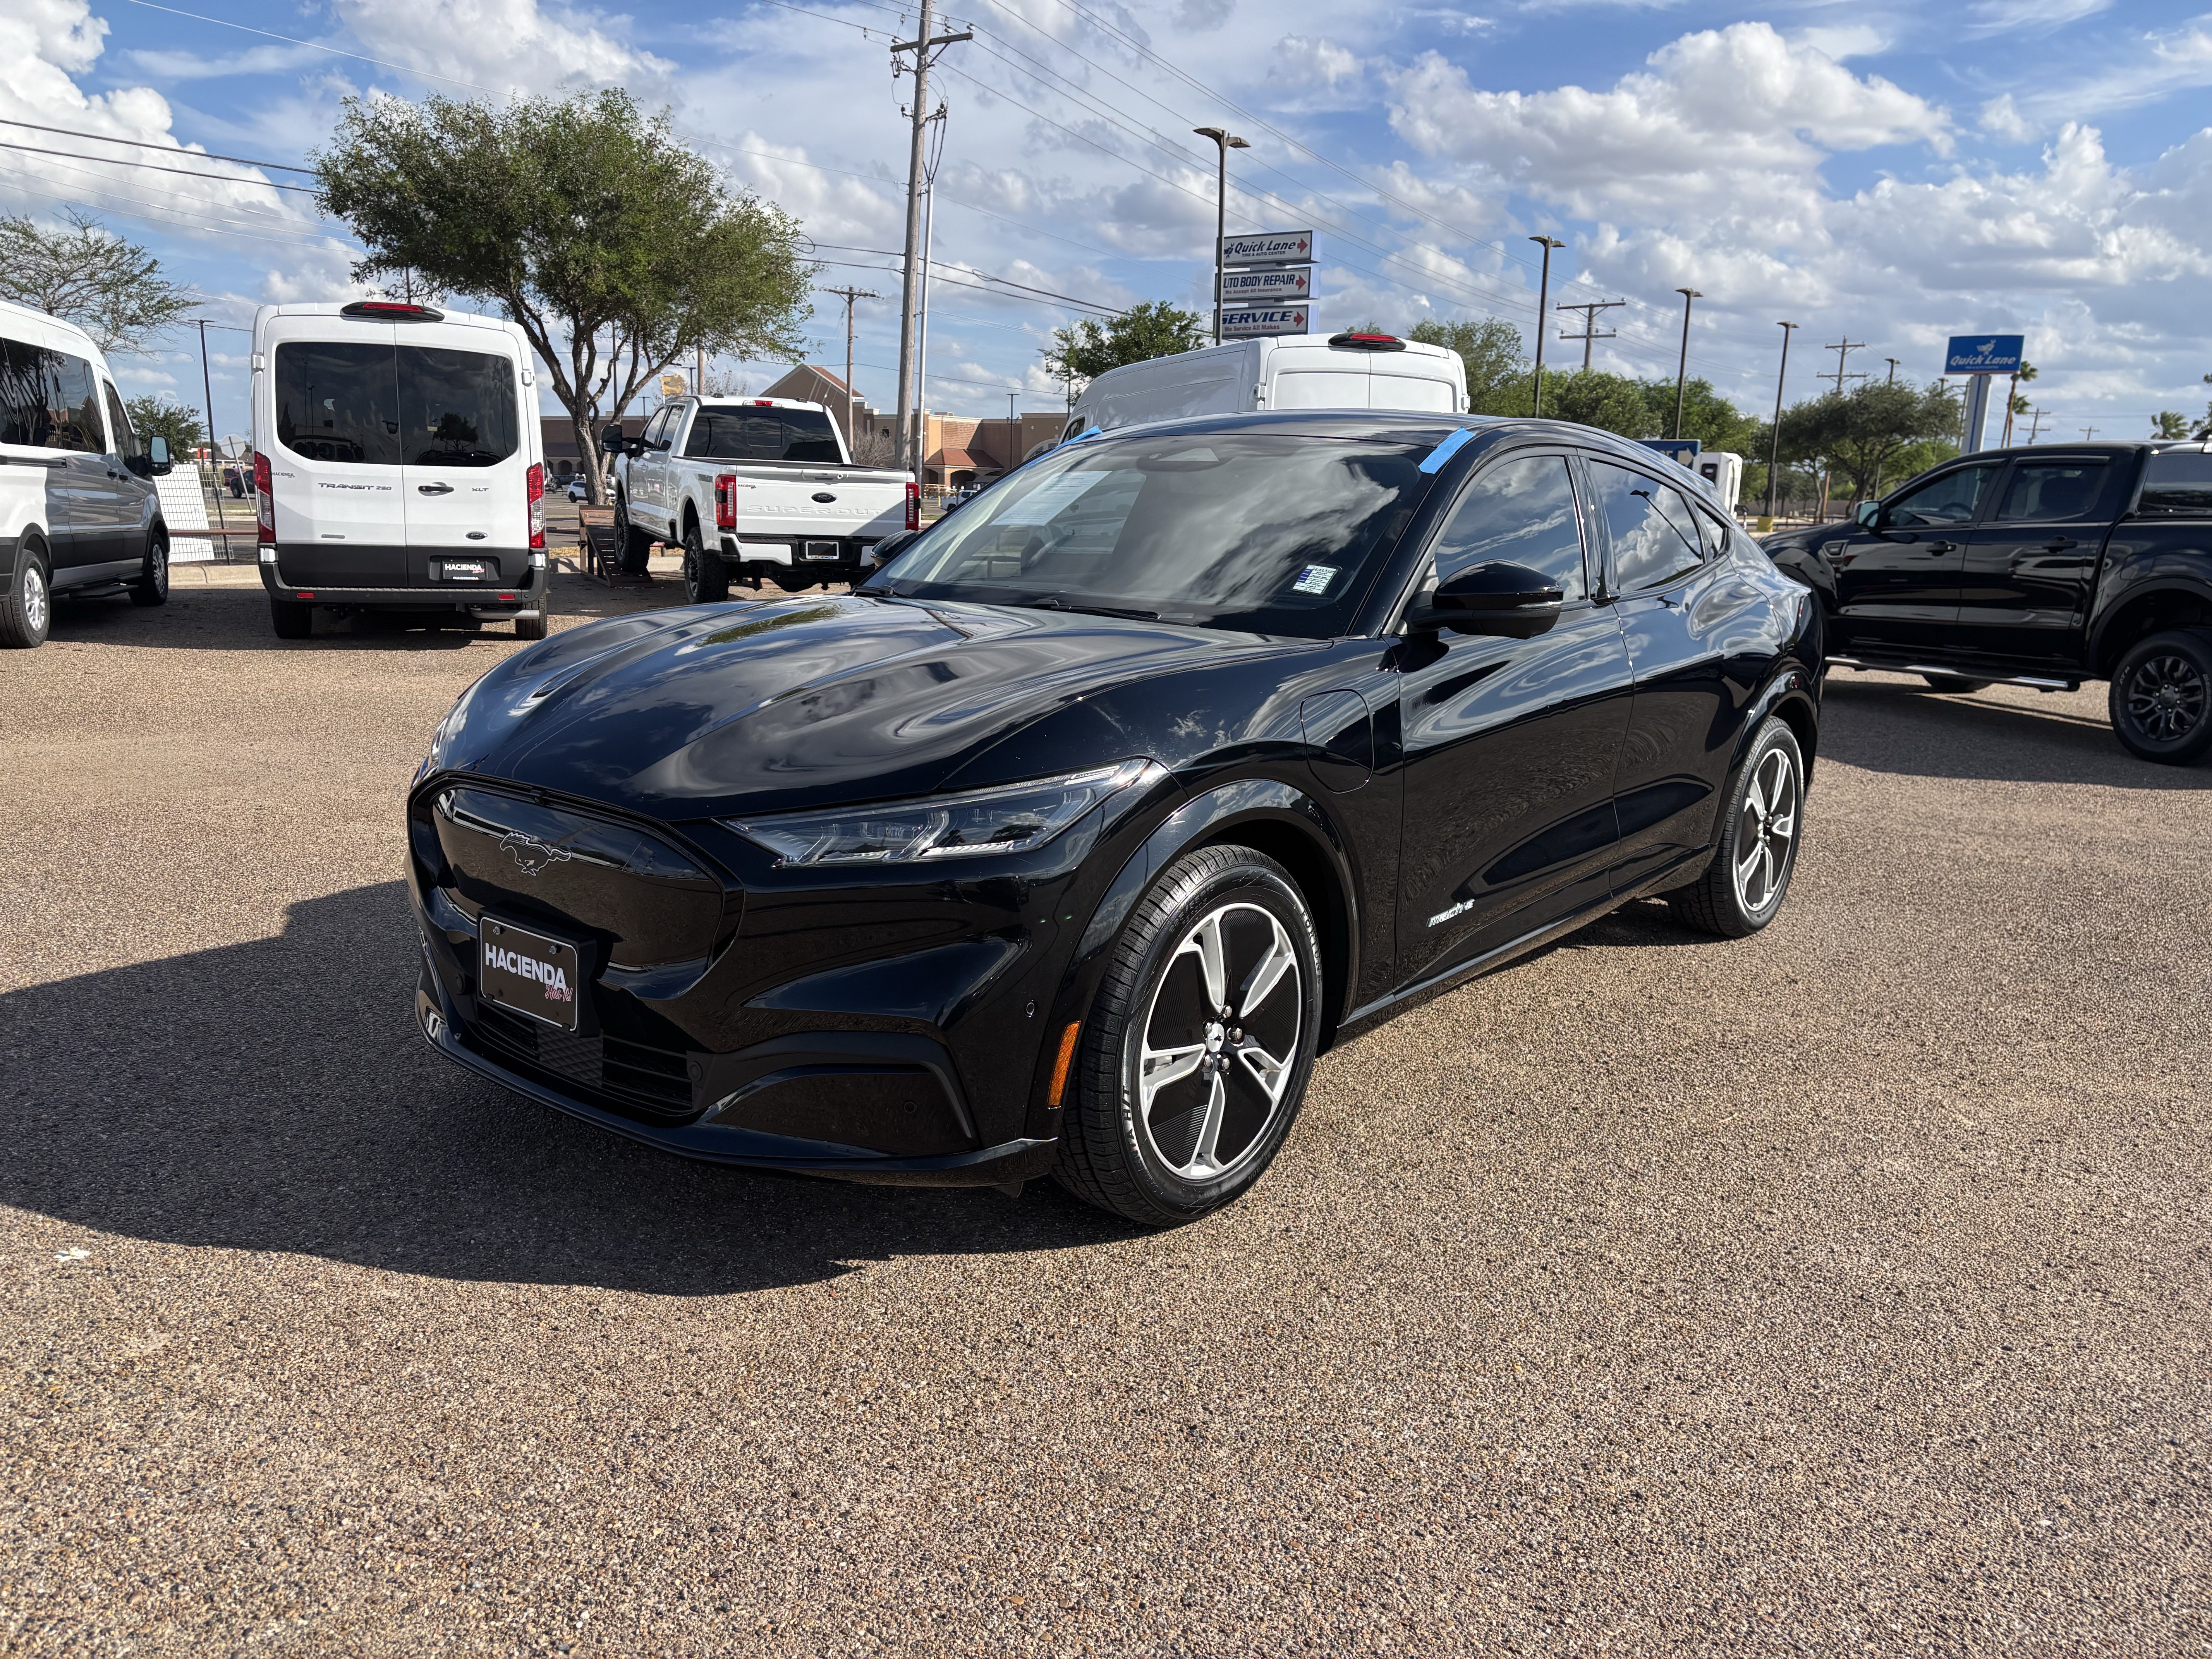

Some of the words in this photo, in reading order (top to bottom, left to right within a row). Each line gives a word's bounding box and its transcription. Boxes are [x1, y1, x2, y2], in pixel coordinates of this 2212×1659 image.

[1235, 241, 1265, 254] Quick
[1266, 240, 1296, 251] Lane
[1223, 277, 1239, 288] UTO
[1240, 275, 1263, 287] BODY
[1263, 274, 1295, 286] REPAIR
[1222, 311, 1293, 325] SERVICE
[1950, 354, 1984, 366] Quick
[1984, 354, 2016, 364] Lane
[747, 505, 830, 515] SUPER
[485, 942, 567, 992] HACIENDA
[544, 983, 563, 1000] Has
[1121, 1085, 1132, 1121] H/T
